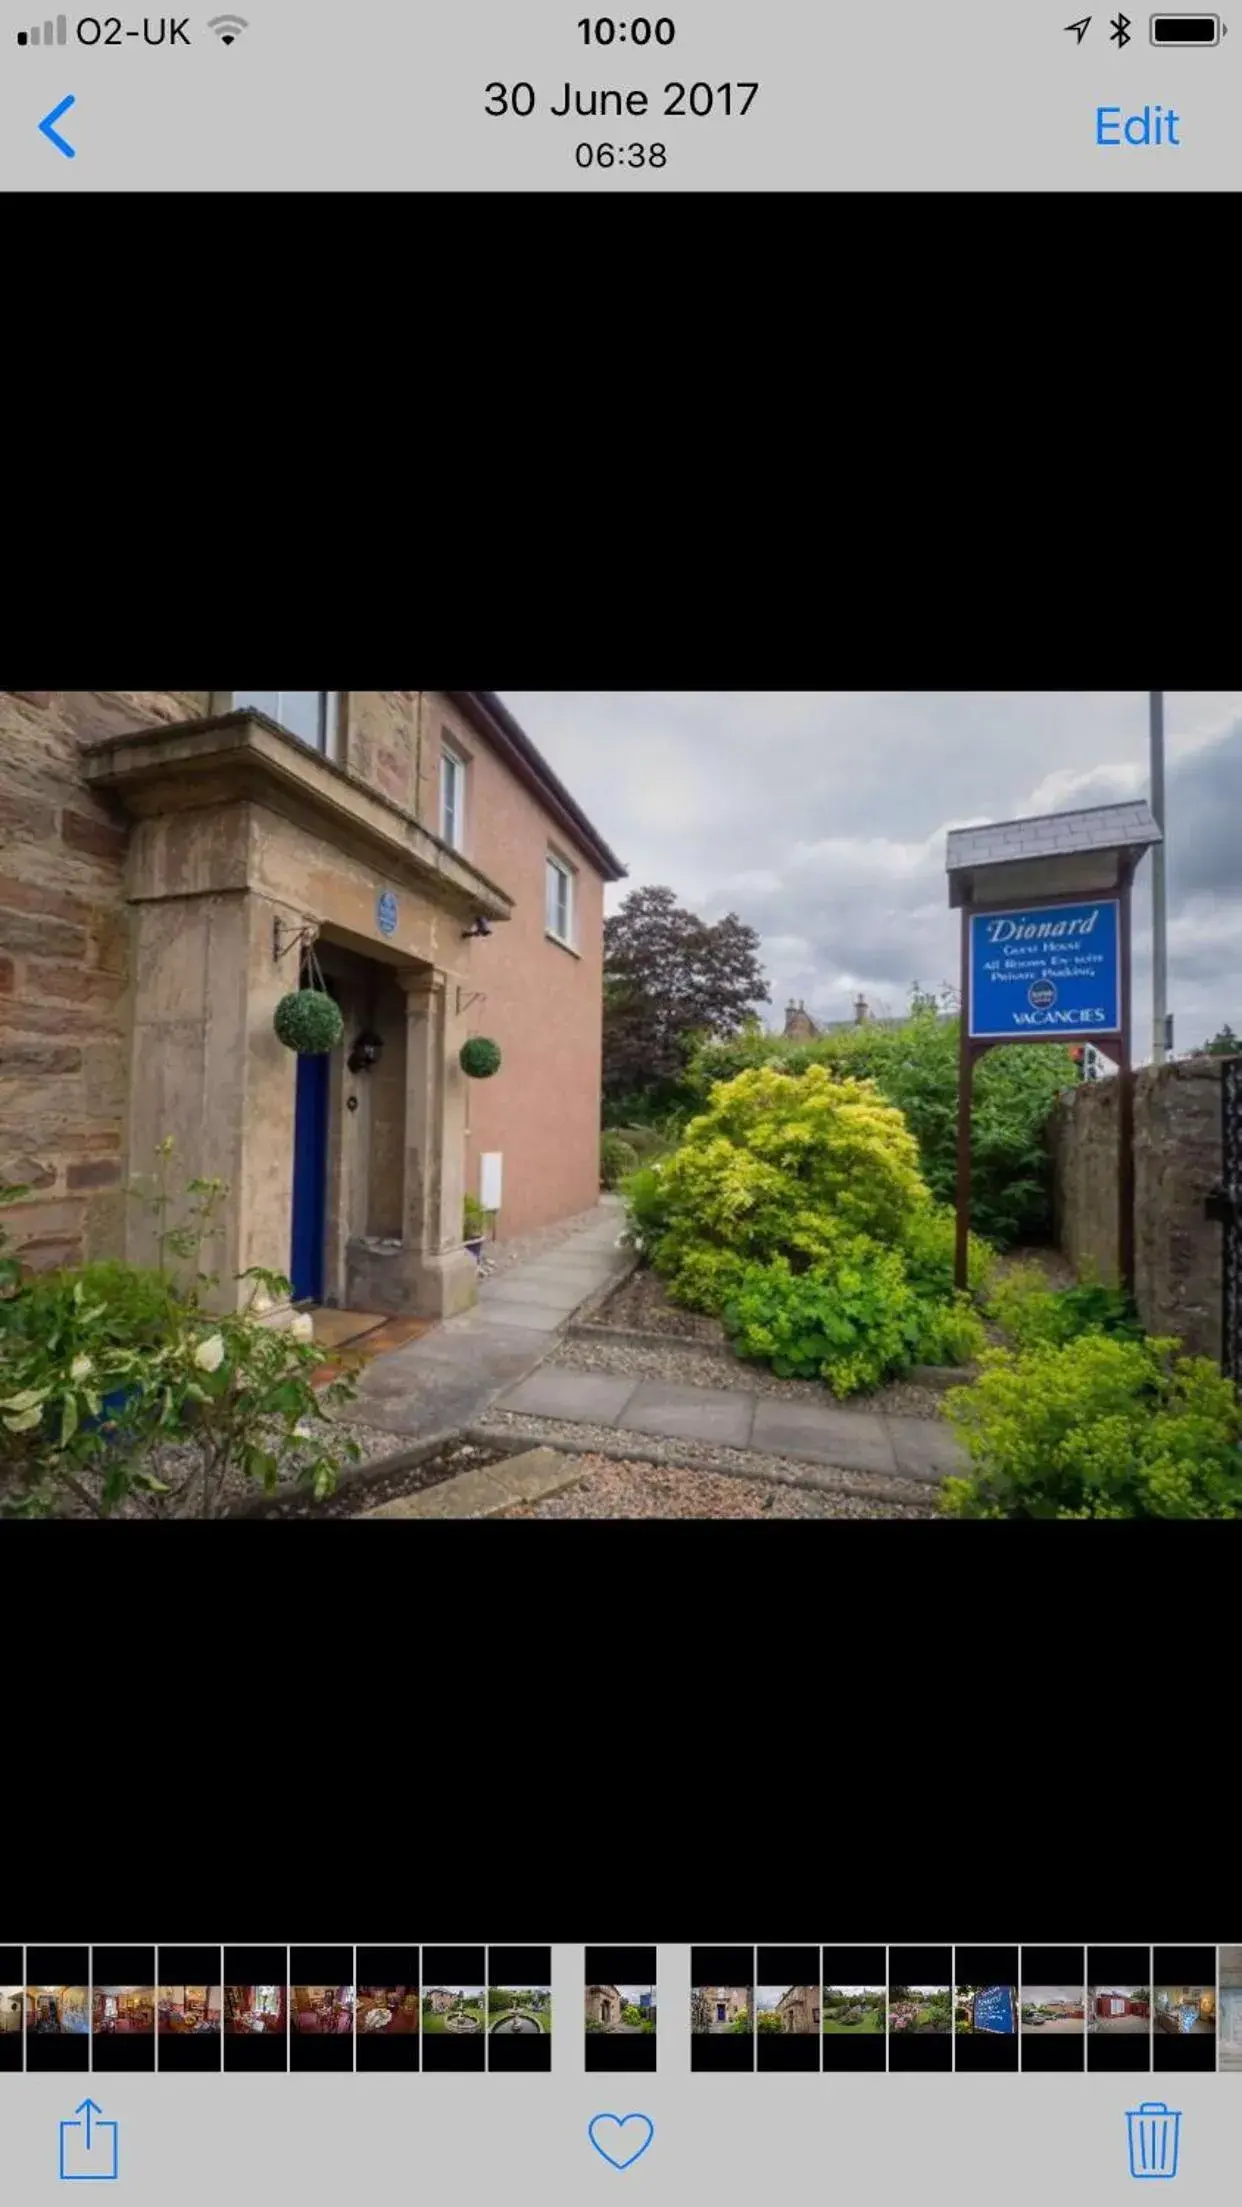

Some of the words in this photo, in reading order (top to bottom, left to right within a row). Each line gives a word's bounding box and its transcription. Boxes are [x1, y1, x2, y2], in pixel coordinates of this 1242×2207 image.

[75, 16, 192, 46] O2-UK
[577, 16, 676, 46] 10:00
[484, 81, 536, 117] 30
[549, 81, 649, 117] June
[663, 81, 760, 117] 2017
[1096, 105, 1180, 146] Edit
[574, 141, 668, 169] 06:38
[986, 909, 1099, 942] Dionard
[1012, 1007, 1106, 1025] VACANCIES
